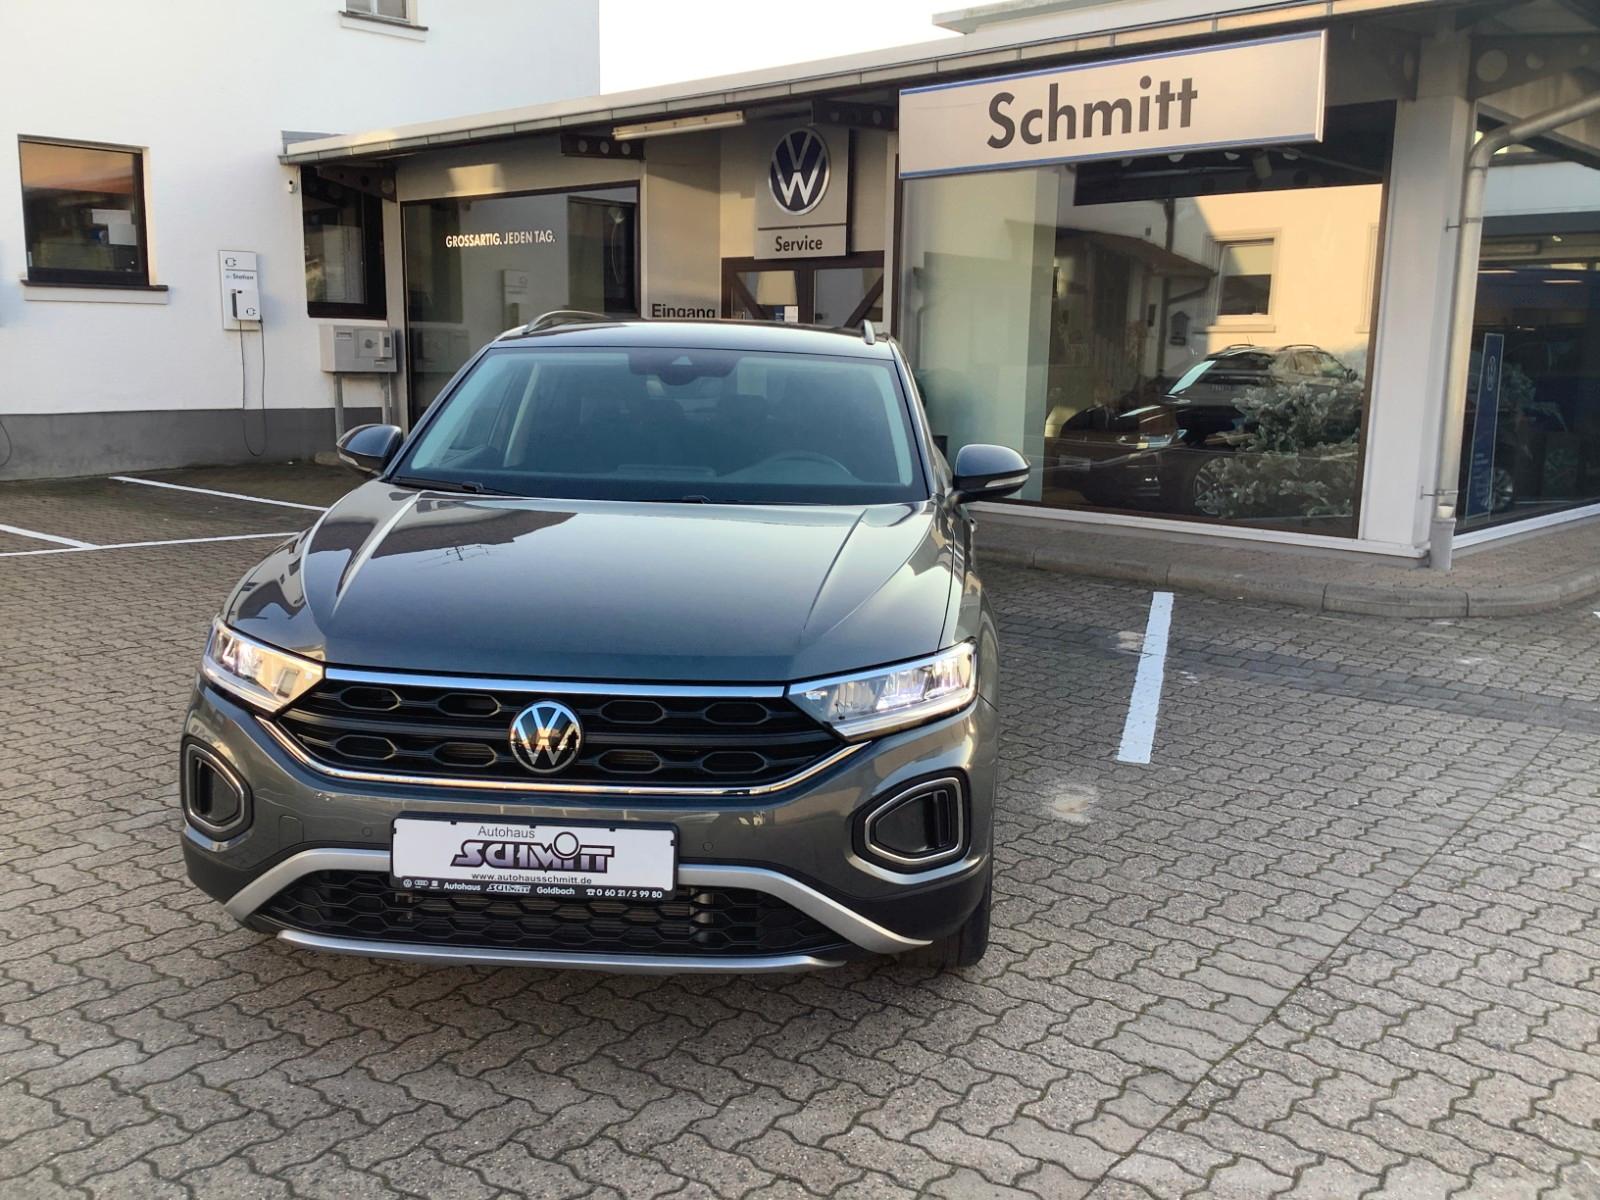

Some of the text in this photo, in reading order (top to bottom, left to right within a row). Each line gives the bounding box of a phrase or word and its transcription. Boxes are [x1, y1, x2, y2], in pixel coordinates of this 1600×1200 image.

[987, 75, 1198, 149] Schmitt
[769, 128, 831, 215] VW
[445, 229, 556, 248] GROSSARTIG. JEDEN TAG.
[775, 235, 823, 252] Service
[651, 303, 716, 319] Eingang
[509, 700, 582, 774] VW
[477, 825, 536, 839] Autohaus
[471, 872, 592, 885] www.autohausschmitt.de
[443, 882, 481, 891] Autohaus
[536, 886, 575, 895] Goldbach
[596, 888, 602, 896] 0
[604, 889, 615, 897] 60
[639, 890, 649, 898] 99
[651, 890, 663, 899] 80
